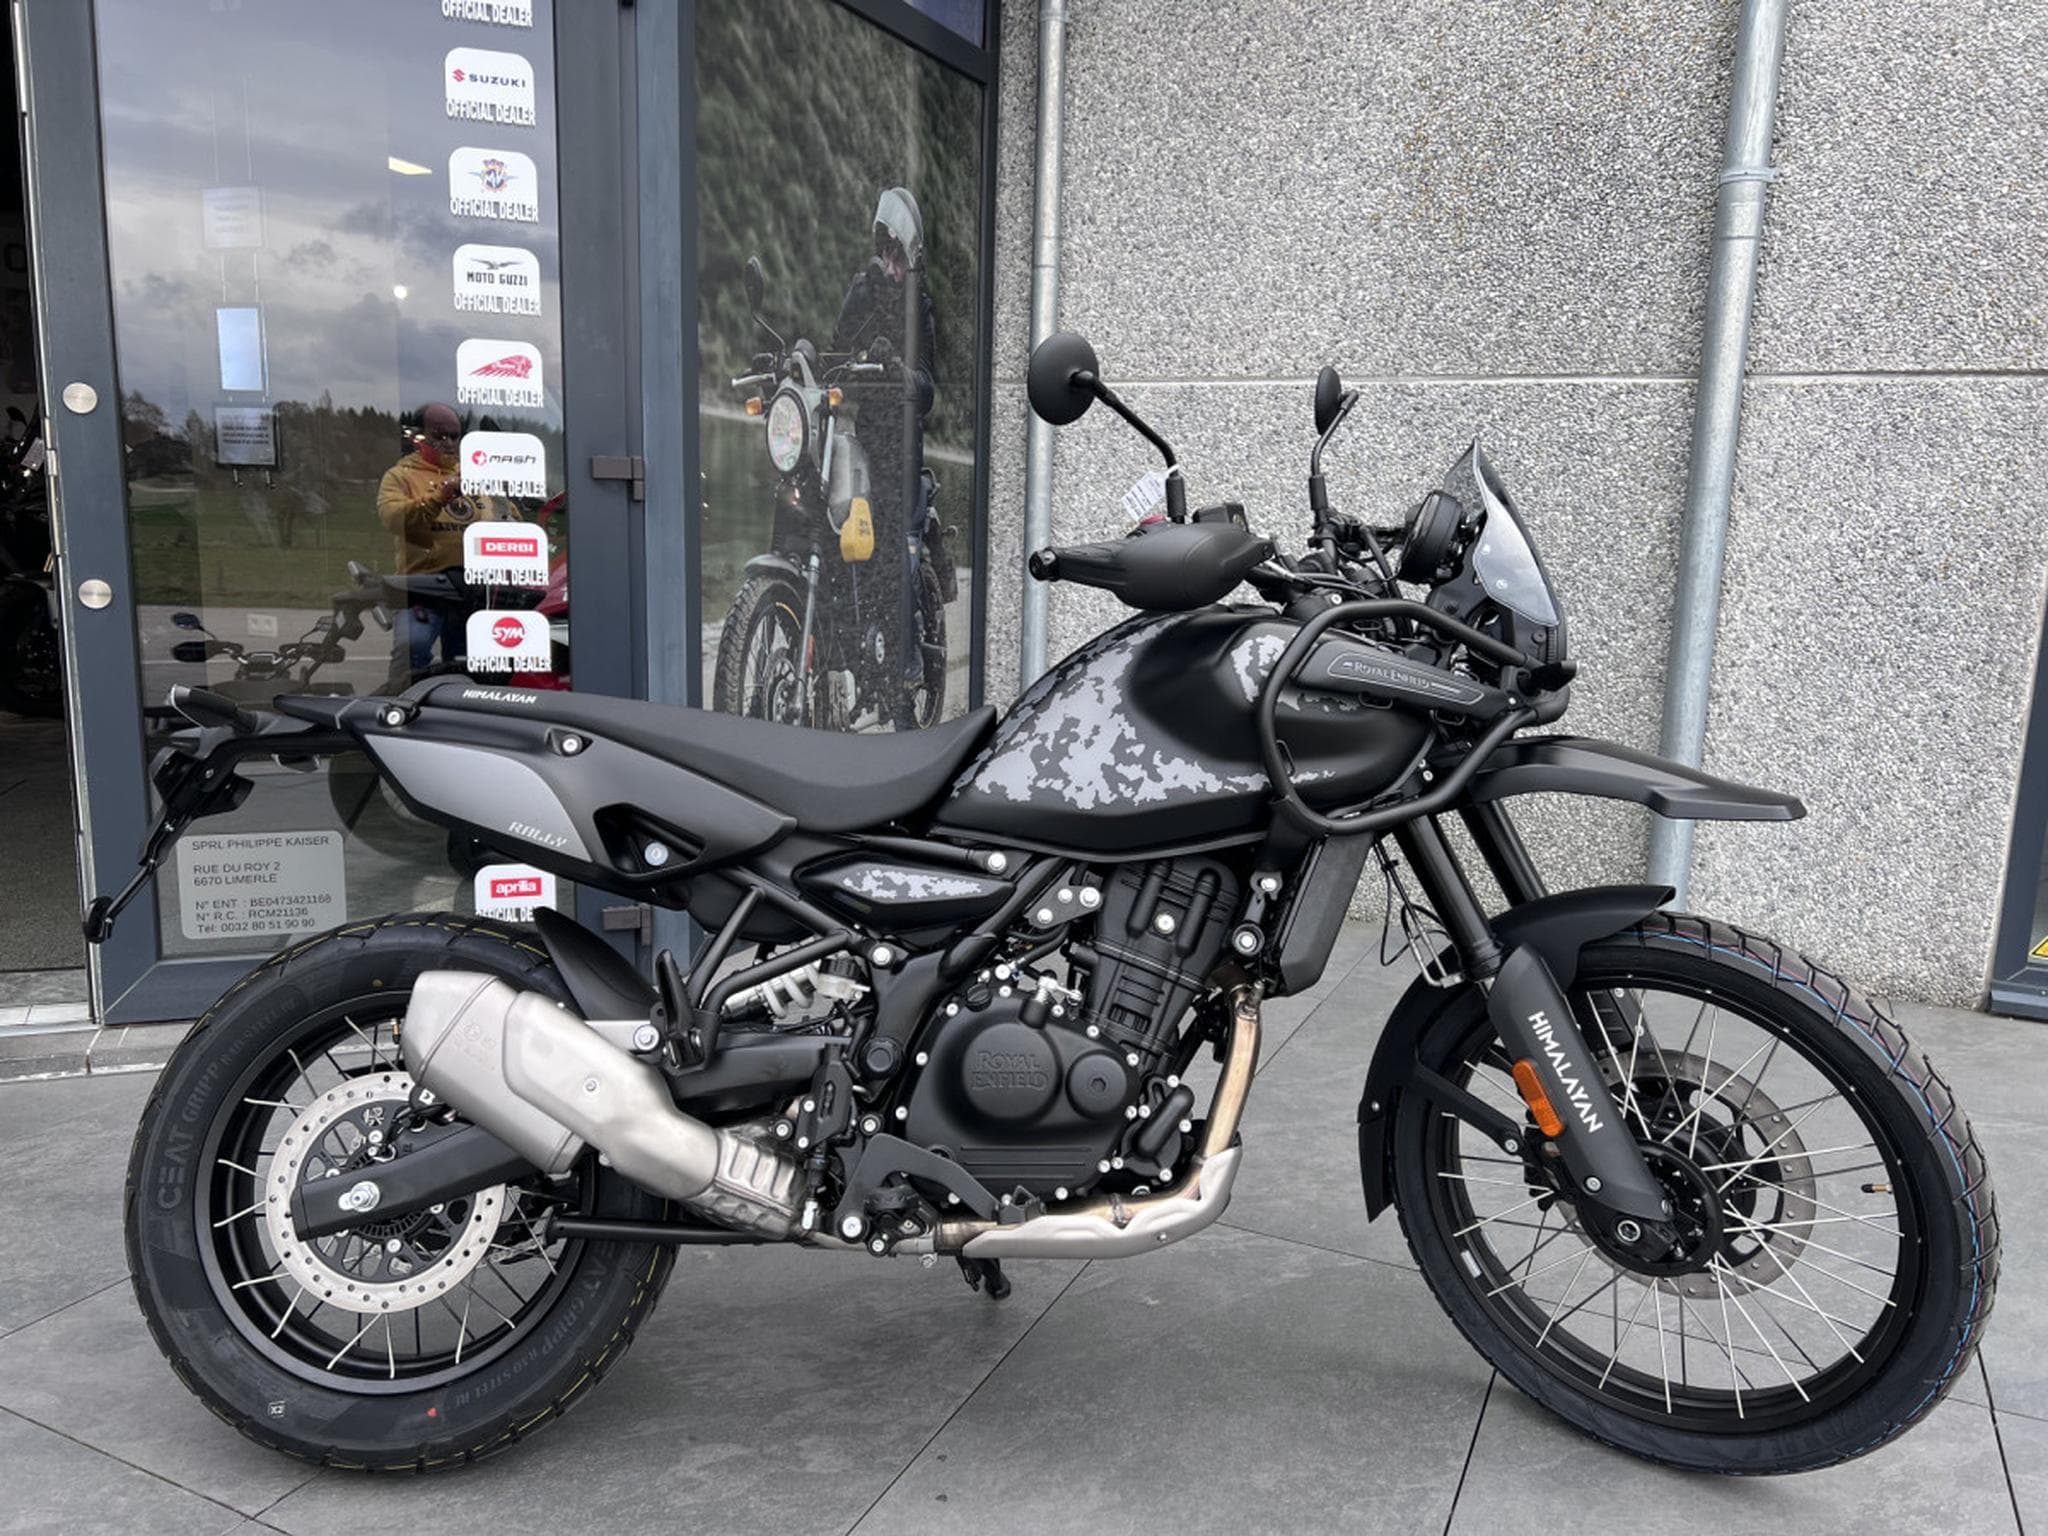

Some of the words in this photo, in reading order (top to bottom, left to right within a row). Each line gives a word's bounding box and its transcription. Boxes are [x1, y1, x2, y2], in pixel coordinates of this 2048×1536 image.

[441, 0, 490, 21] OFFICIAL
[492, 4, 532, 27] DEALER
[468, 73, 526, 88] SUZUKI
[446, 99, 494, 121] OFFICIAL
[496, 103, 536, 126] DEALER
[451, 197, 497, 218] OFFICIAL
[500, 200, 539, 222] DEALER
[467, 271, 495, 284] MOTO
[500, 274, 528, 286] GUZZI
[454, 293, 500, 313] OFFICIAL
[503, 297, 541, 317] DEALER
[458, 386, 503, 405] OFFICIAL
[506, 388, 544, 408] DEALER
[461, 479, 505, 496] OFFICIAL
[508, 480, 547, 498] DEALER
[485, 541, 534, 552] DERBI
[464, 568, 509, 585] OFFICIAL
[512, 569, 549, 586] DEALER
[492, 627, 525, 642] SYM
[468, 656, 512, 672] OFFICIAL
[514, 657, 552, 673] DEALER
[462, 689, 537, 704] HIMALAYAN
[508, 821, 568, 847] RALLY
[192, 840, 224, 851] SPRL
[227, 838, 283, 849] PHILIPPE
[286, 836, 329, 846] KAISER
[193, 864, 219, 874] RUE
[223, 863, 241, 873] DU
[244, 862, 271, 872] ROY
[273, 861, 281, 871] 2
[193, 876, 222, 886] 6670
[225, 873, 278, 885] LIMERLE
[495, 880, 537, 896] aprilia
[976, 1050, 1040, 1069] ROYAL
[972, 1070, 1049, 1091] ENFIELD
[1528, 1011, 1604, 1133] HIMALAYAN
[157, 1124, 195, 1209] CEAT
[181, 1062, 223, 1123] GRIPP
